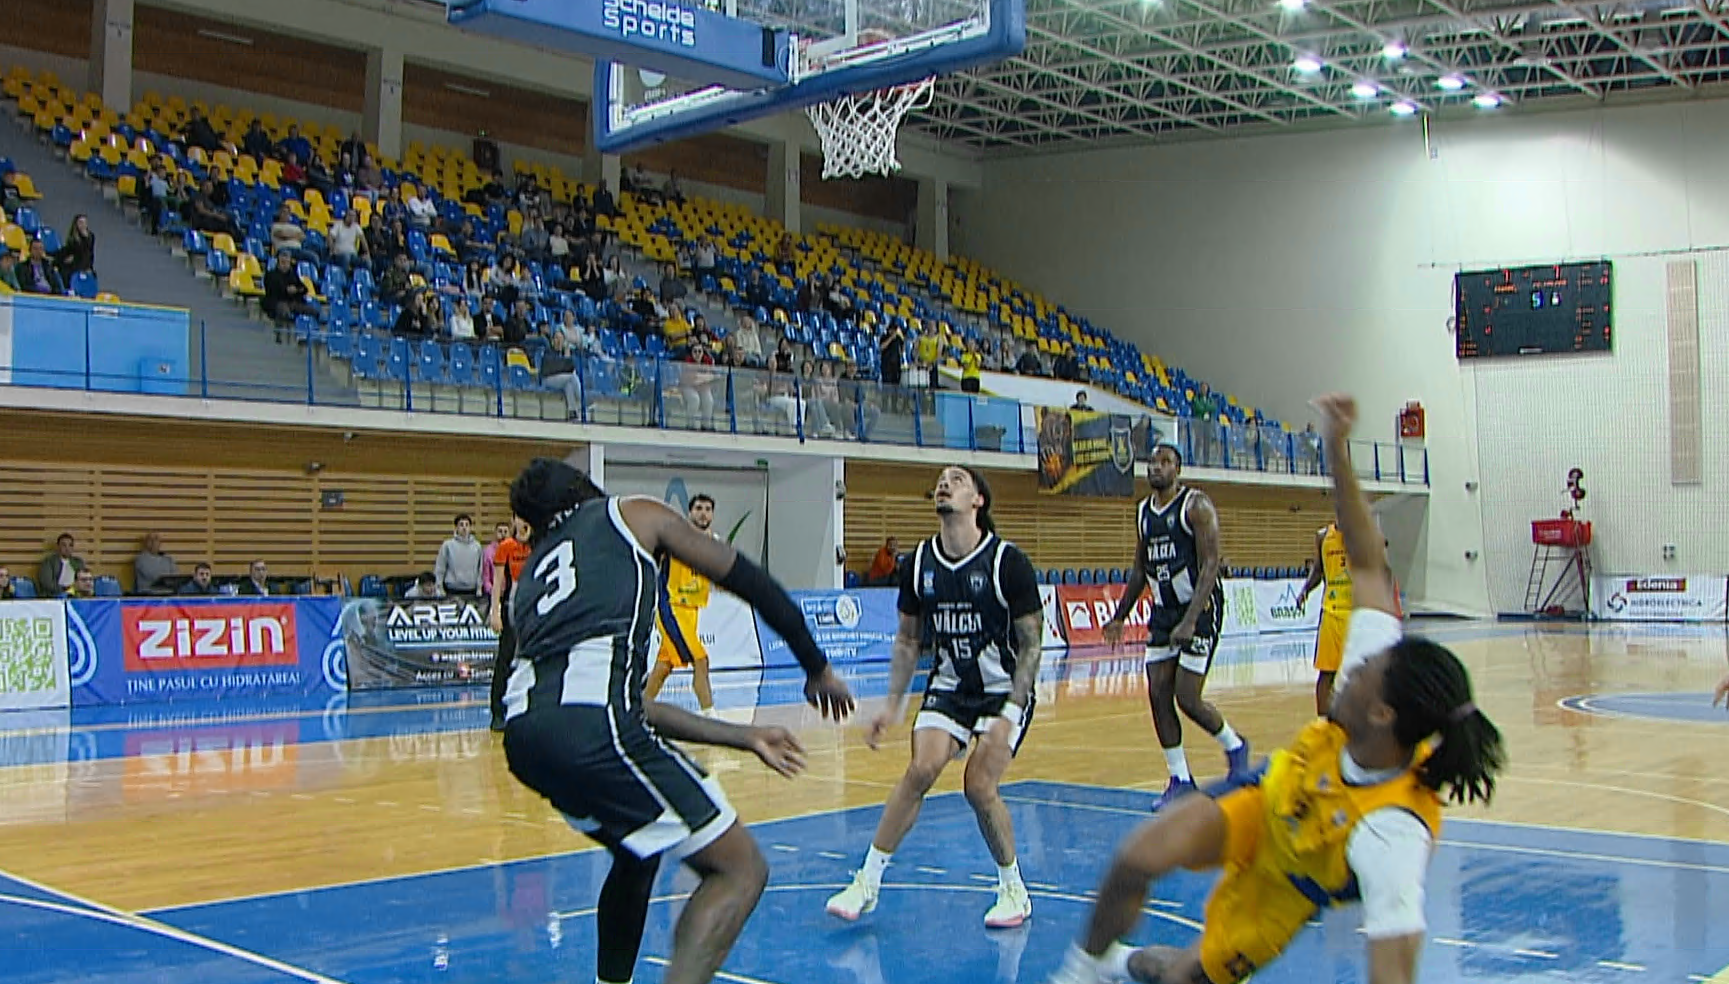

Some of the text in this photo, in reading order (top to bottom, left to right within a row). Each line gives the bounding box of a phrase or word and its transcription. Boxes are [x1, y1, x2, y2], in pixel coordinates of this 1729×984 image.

[604, 8, 694, 46] Sports
[533, 540, 577, 616] 3
[1156, 563, 1171, 581] 25
[386, 604, 484, 626] AREA
[389, 628, 421, 641] LEVEL
[422, 627, 438, 641] UP
[440, 626, 470, 641] YOUR
[951, 637, 973, 660] 15
[158, 675, 197, 691] PASUL
[200, 674, 219, 689] CU
[222, 671, 301, 688] HIDRATAREA!
